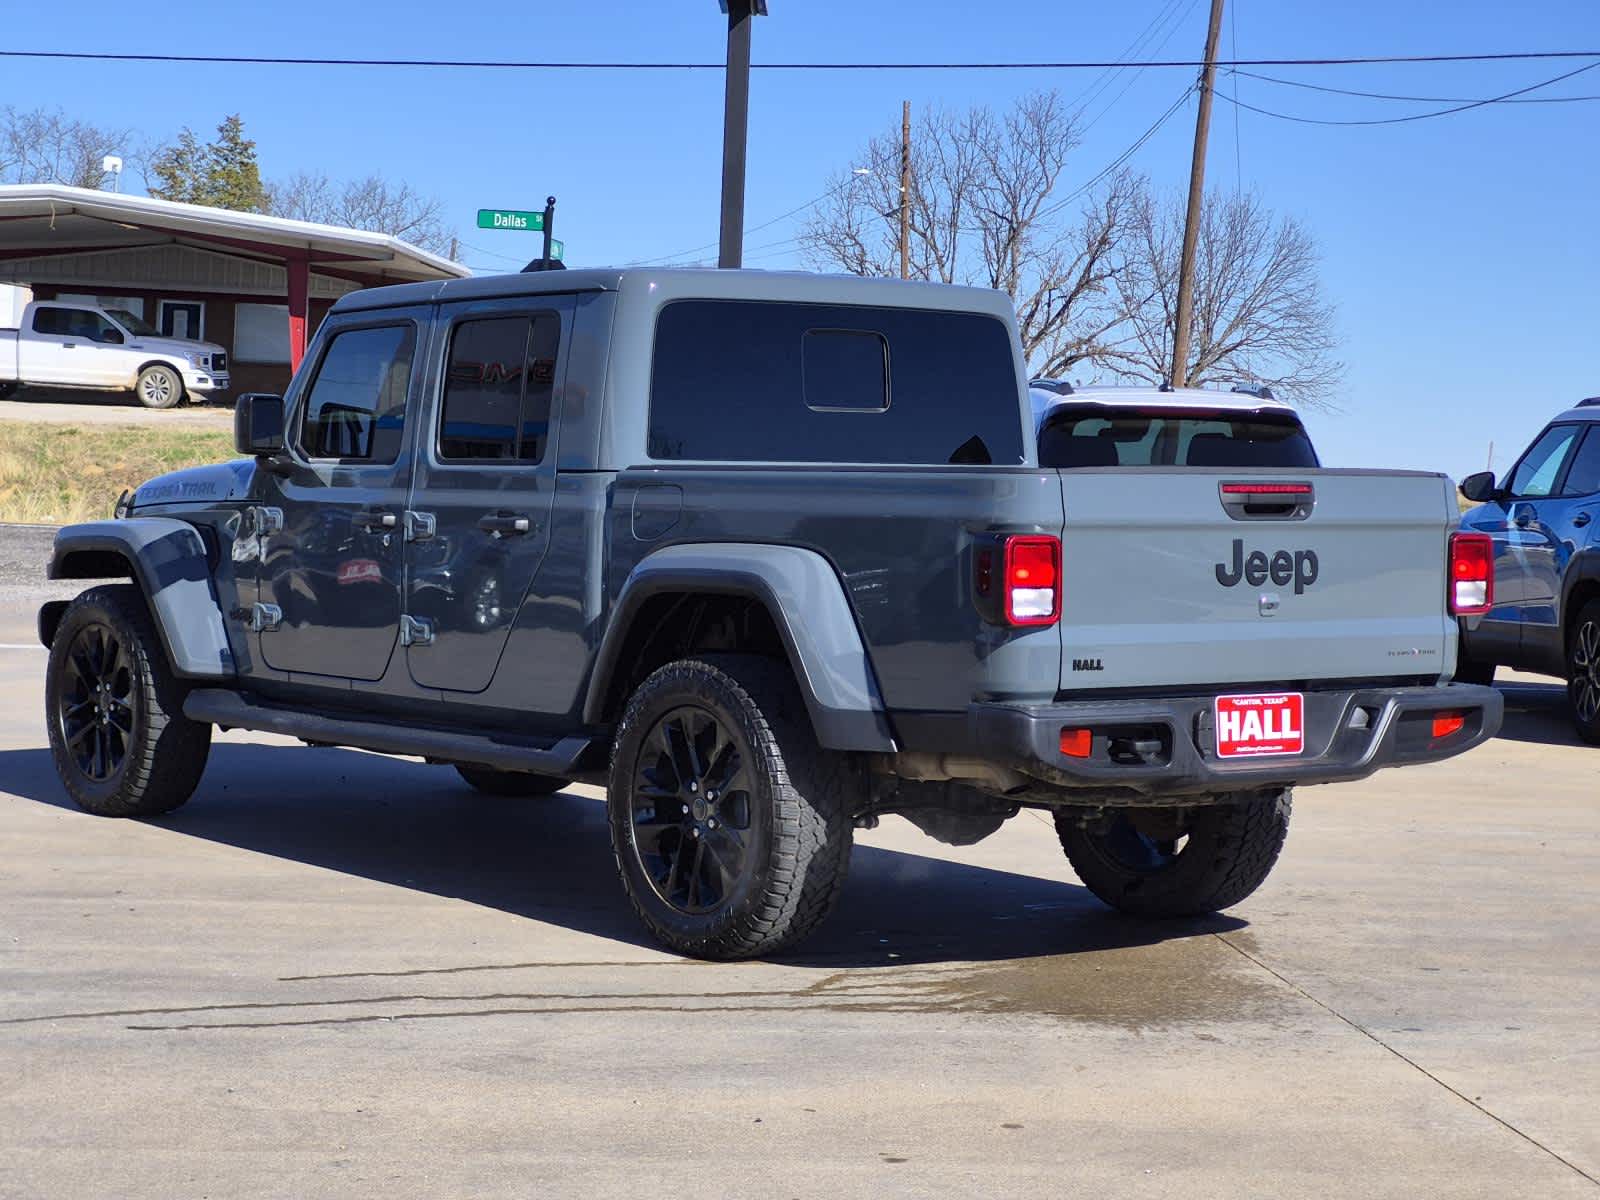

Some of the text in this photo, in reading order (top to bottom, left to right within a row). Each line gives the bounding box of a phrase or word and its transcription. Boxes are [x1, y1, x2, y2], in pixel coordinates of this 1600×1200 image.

[494, 213, 527, 227] Dallas
[1215, 538, 1319, 595] Jeep
[1072, 659, 1104, 671] HALL
[1219, 708, 1301, 742] HALL
